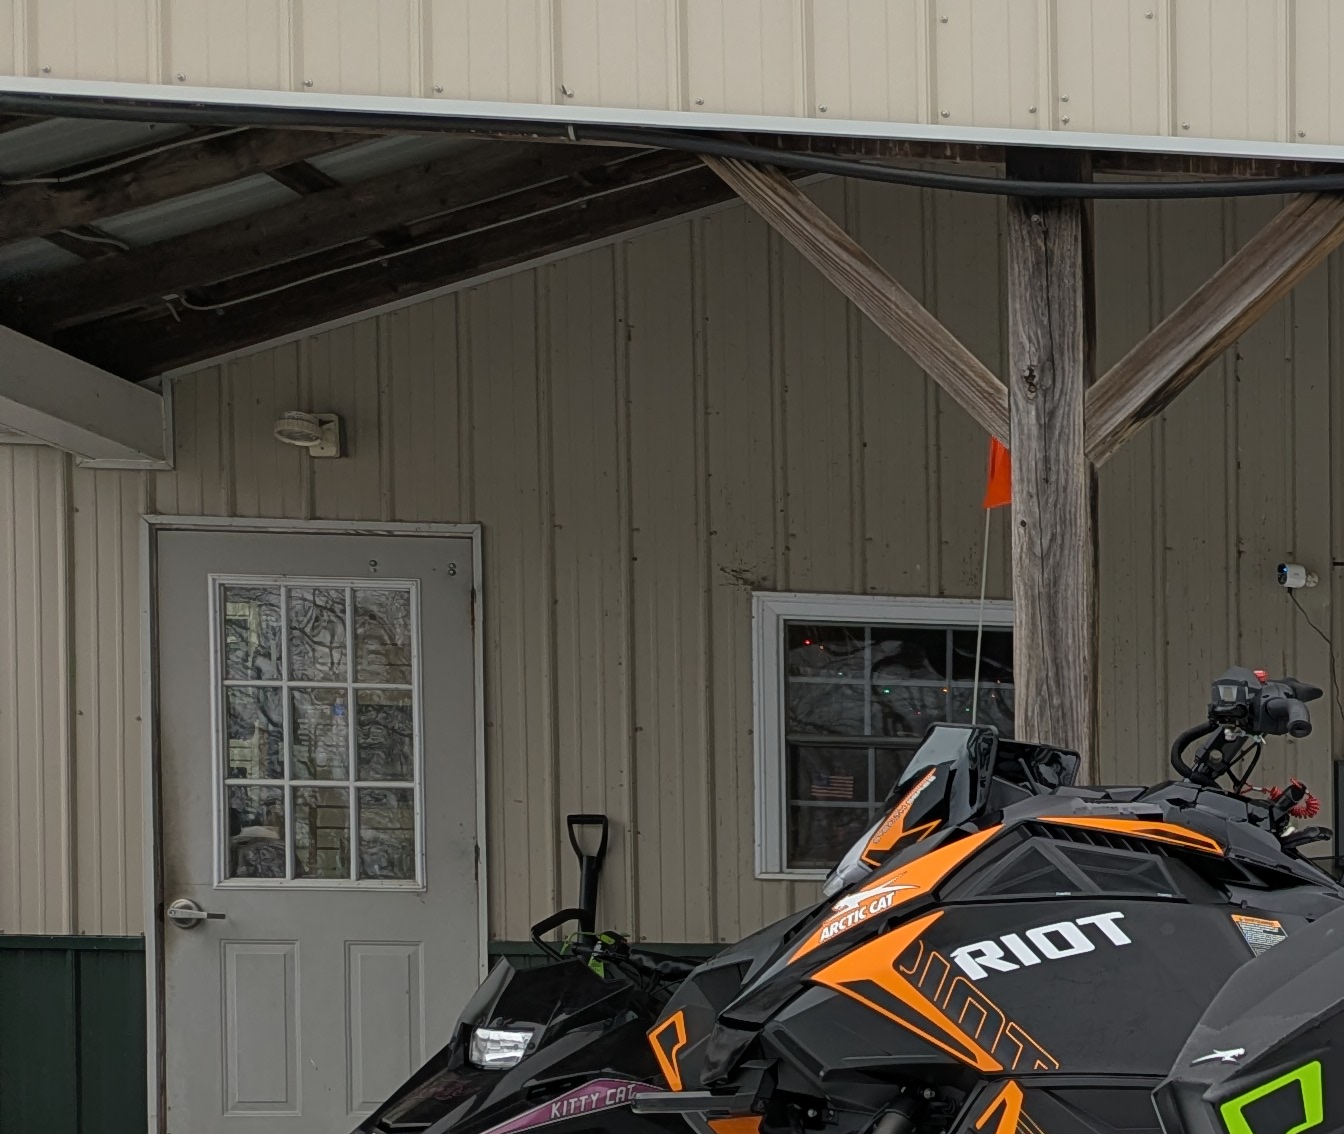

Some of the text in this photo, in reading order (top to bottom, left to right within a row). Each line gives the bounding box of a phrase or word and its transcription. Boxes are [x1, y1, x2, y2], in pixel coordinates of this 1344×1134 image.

[819, 891, 896, 942] ARCTIC CAT
[950, 911, 1132, 981] RIOT
[550, 1083, 637, 1119] KITTY CAT
